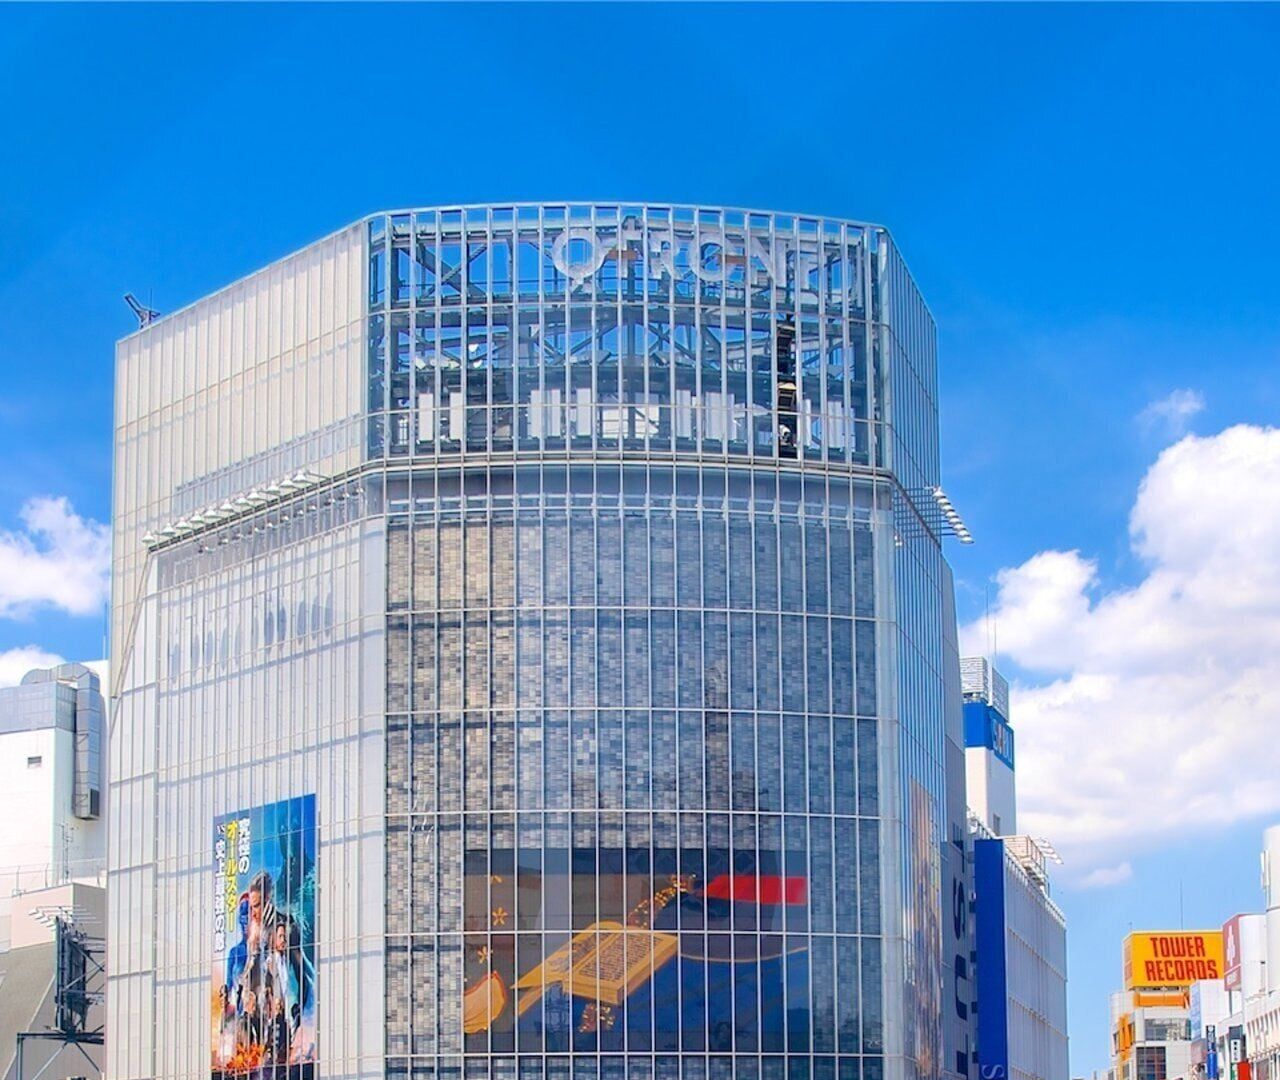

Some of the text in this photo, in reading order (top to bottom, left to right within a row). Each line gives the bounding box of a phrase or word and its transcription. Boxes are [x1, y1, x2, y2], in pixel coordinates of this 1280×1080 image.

[226, 820, 238, 933] オールスター
[1150, 936, 1206, 958] TOWER
[1144, 959, 1218, 981] RECORDS
